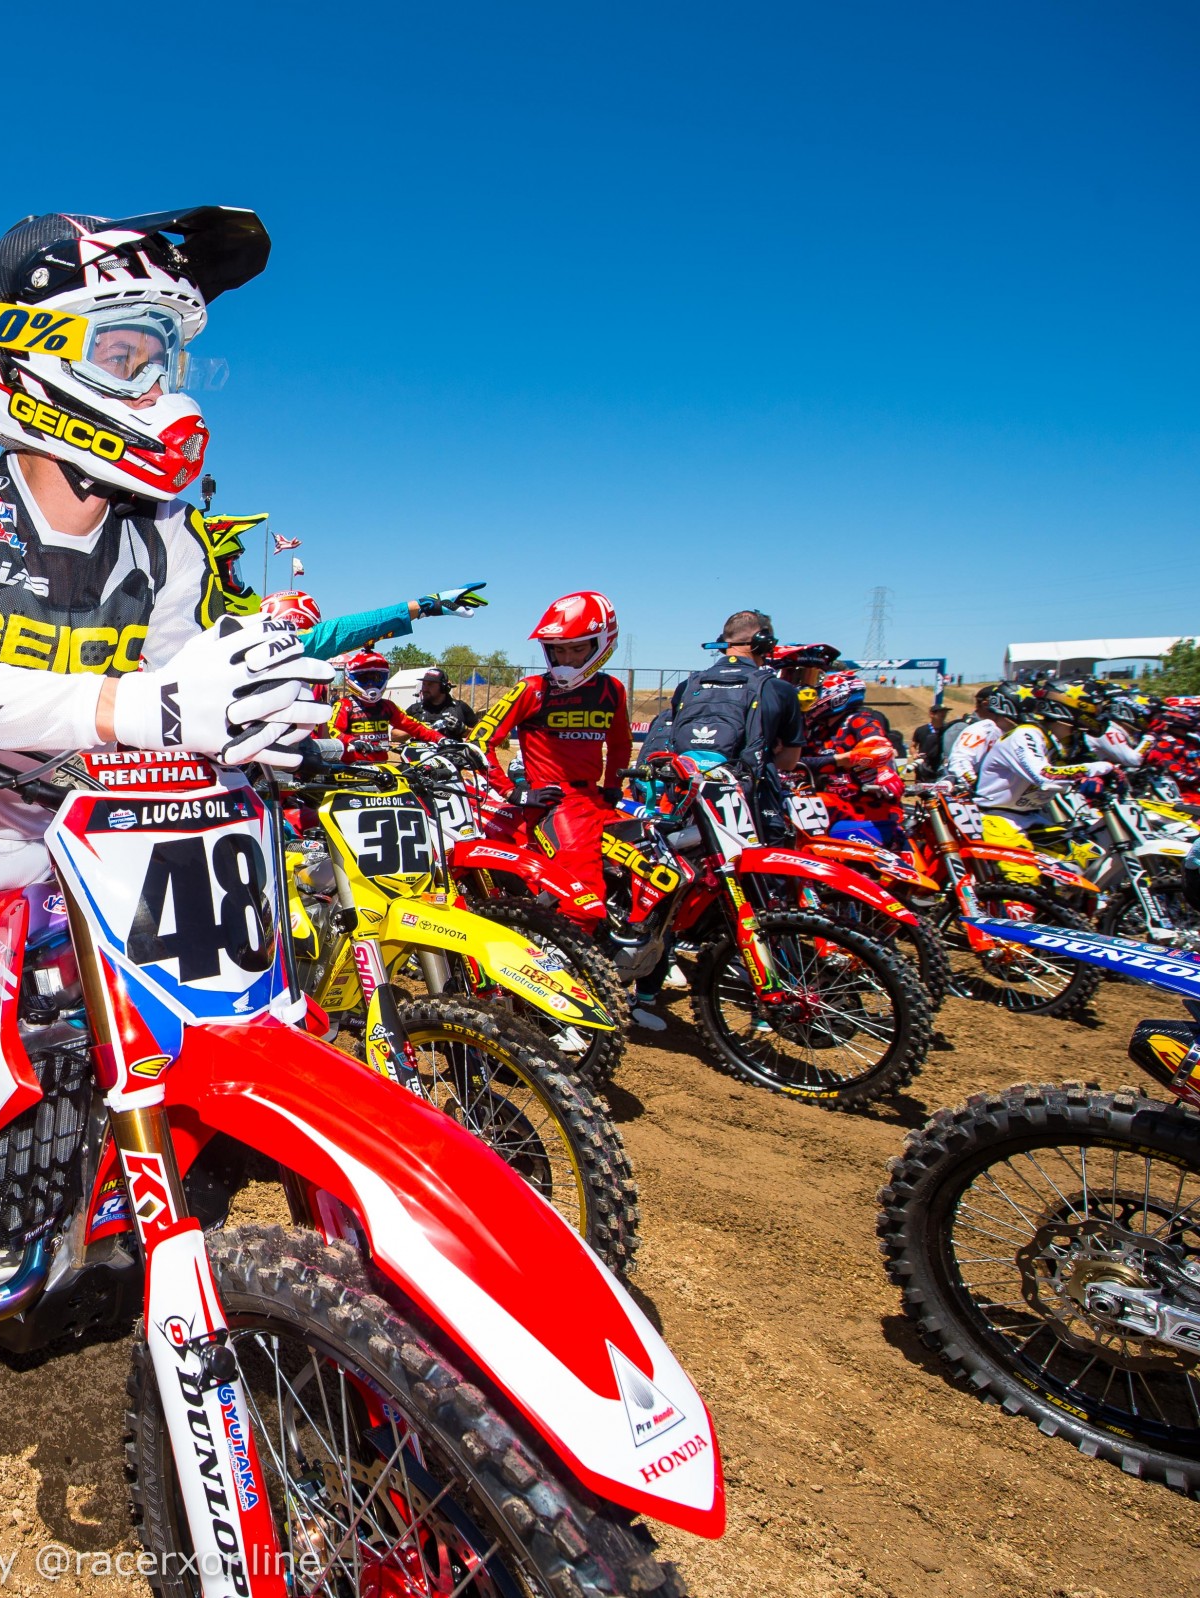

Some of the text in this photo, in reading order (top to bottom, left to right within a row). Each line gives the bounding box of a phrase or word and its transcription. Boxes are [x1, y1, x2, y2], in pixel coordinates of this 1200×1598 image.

[10, 392, 126, 461] GEICO
[583, 647, 613, 679] GEICO
[960, 732, 987, 749] FLY
[98, 766, 212, 786] RENTHAL
[142, 800, 231, 825] LUCAS OIL
[366, 797, 404, 807] LUCAS OIL
[481, 803, 513, 819] HONDA
[359, 809, 431, 878] 32
[601, 831, 680, 893] GEICO
[634, 878, 660, 899] HONDA
[126, 833, 276, 986] 48
[432, 924, 468, 941] TOYOTA
[500, 966, 550, 998] Autotrader
[742, 947, 763, 986] GEICO
[442, 1022, 511, 1058] DUNLOP
[635, 1406, 675, 1435] Pro Honda
[225, 1402, 259, 1514] YUTAKA
[226, 1437, 234, 1461] Clean
[238, 1485, 247, 1511] Future
[638, 1434, 709, 1484] HONDA
[176, 1366, 250, 1598] DUNLOP
